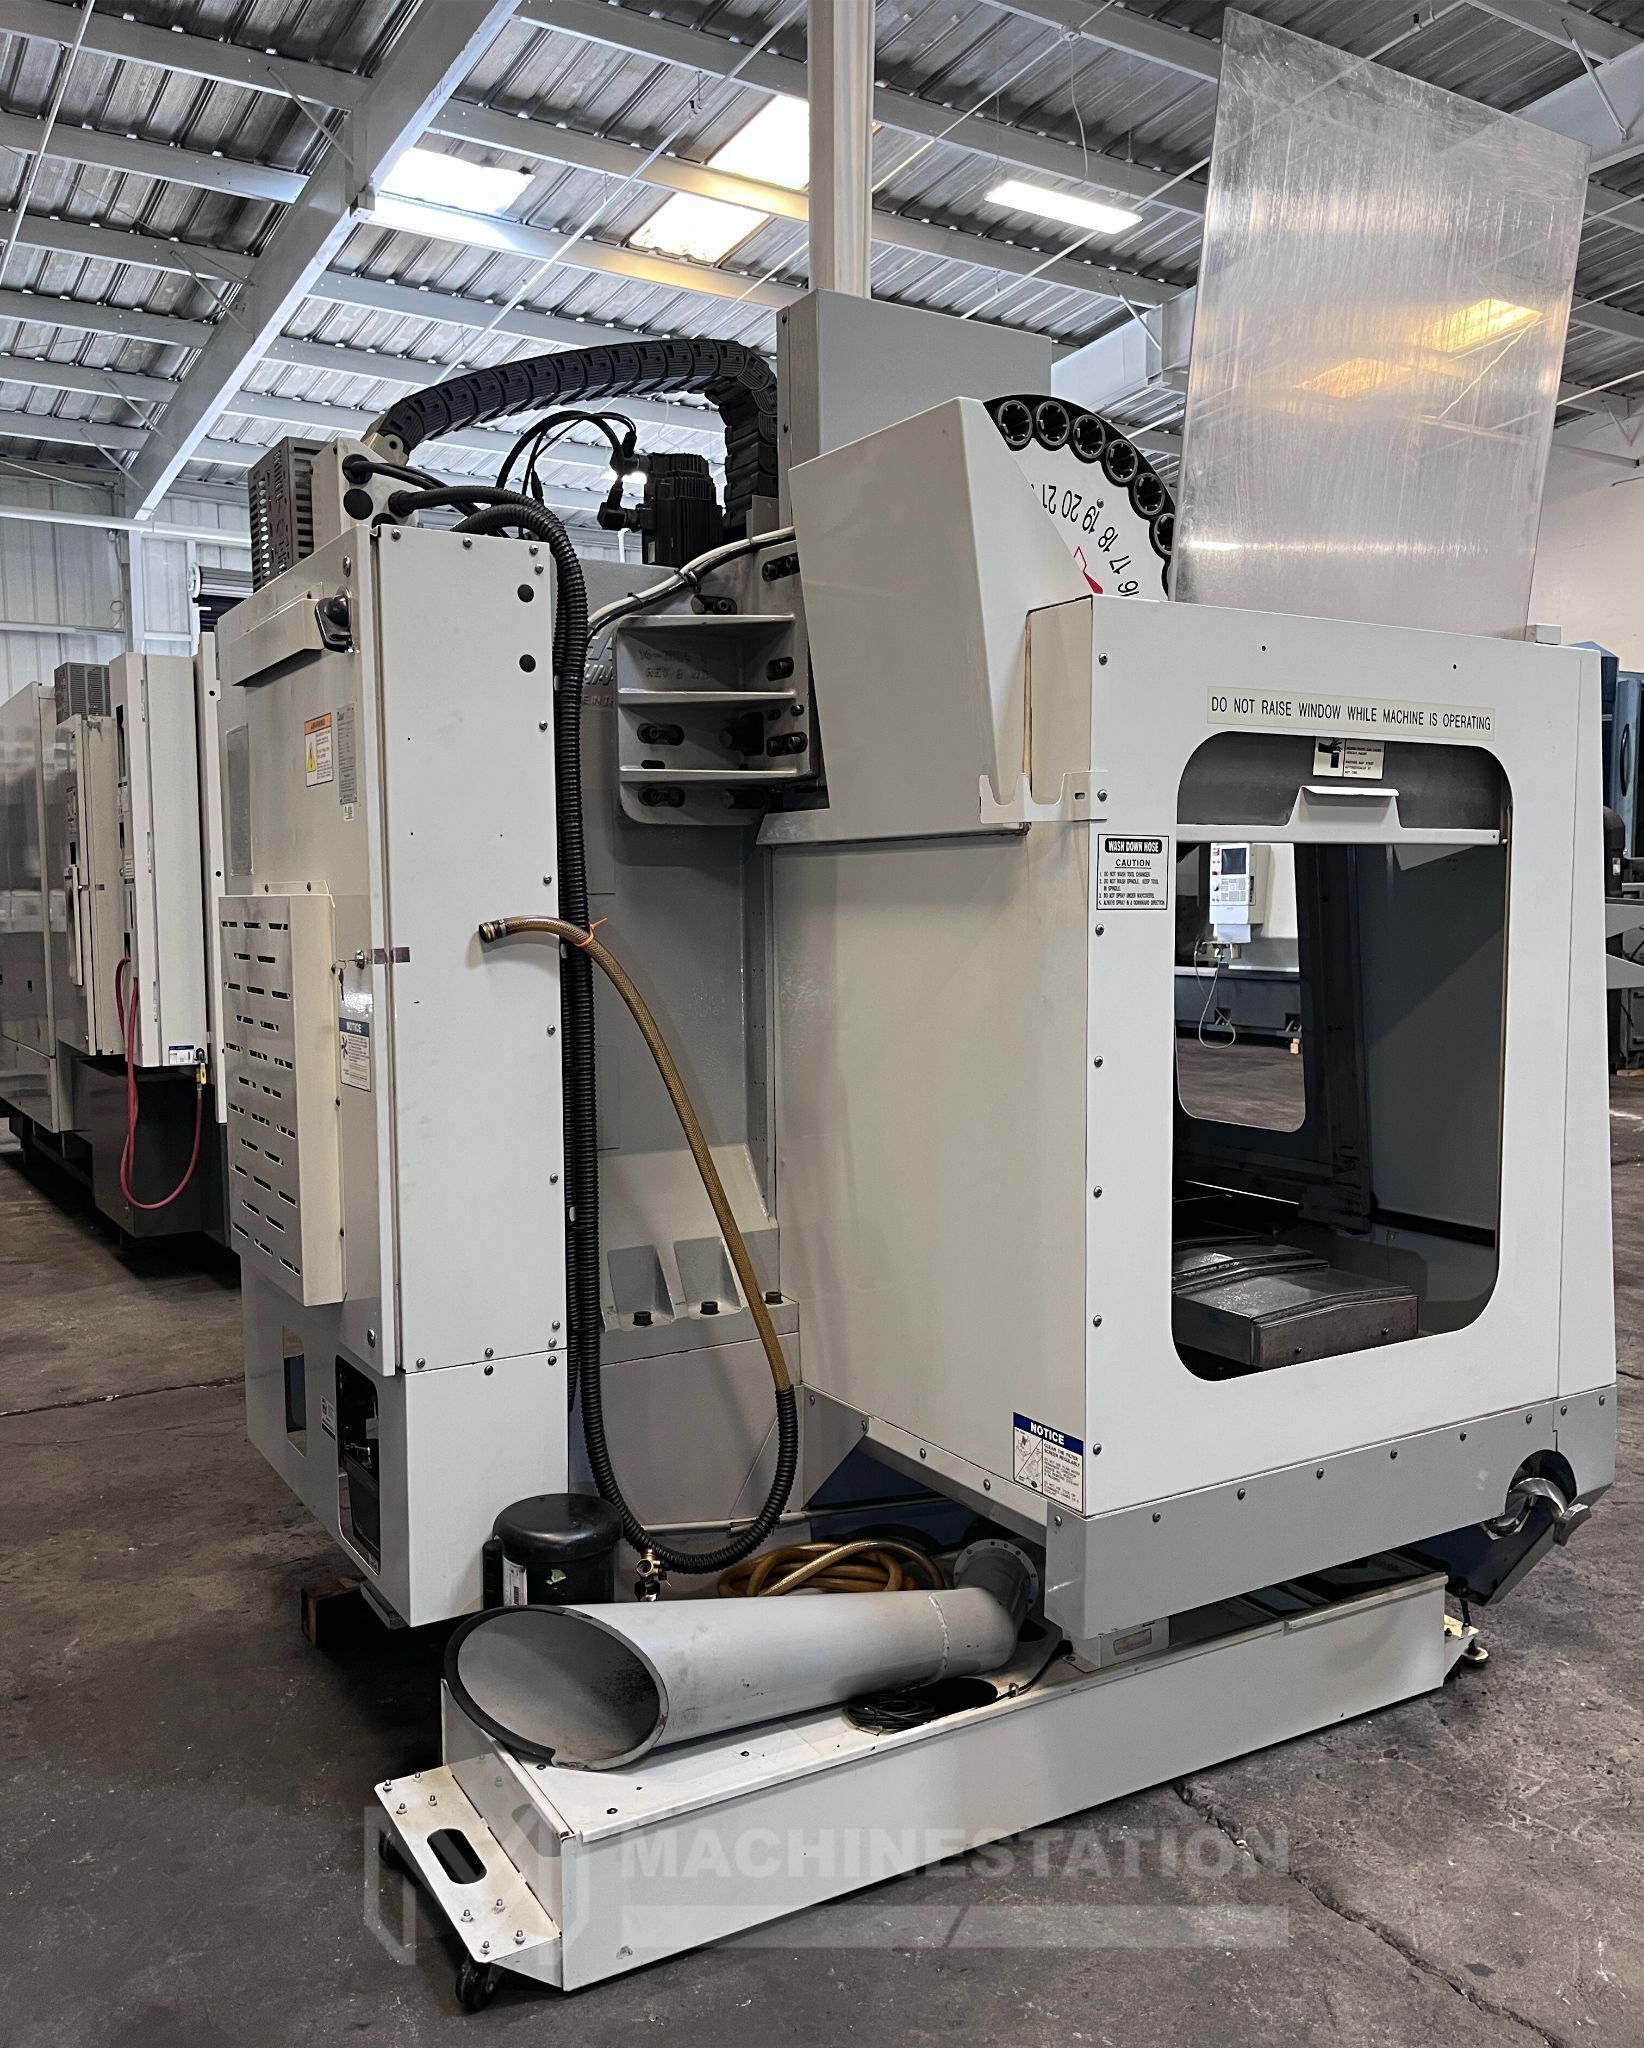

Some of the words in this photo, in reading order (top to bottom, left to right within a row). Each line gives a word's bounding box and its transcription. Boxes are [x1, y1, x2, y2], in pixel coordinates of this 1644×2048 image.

[1042, 484, 1057, 514] 21
[1061, 490, 1082, 522] 20
[1082, 505, 1100, 534] 19
[1098, 526, 1118, 552] 18
[1109, 555, 1131, 574] 17
[1211, 696, 1228, 713] DO
[1233, 697, 1256, 715] NOT
[1261, 699, 1292, 717] RAISE
[1298, 702, 1342, 720] WINDOW
[1347, 705, 1377, 722] WHILE
[1383, 708, 1424, 726] MACHINE
[1429, 712, 1438, 727] IS
[1442, 713, 1491, 731] OPERATING
[1108, 840, 1125, 852] WASH
[1125, 840, 1143, 852] DOWN
[1143, 841, 1159, 853] HOSE
[1115, 858, 1151, 867] CAUTION
[346, 1021, 362, 1033] NOTICE
[1030, 1421, 1065, 1446] NOTICE
